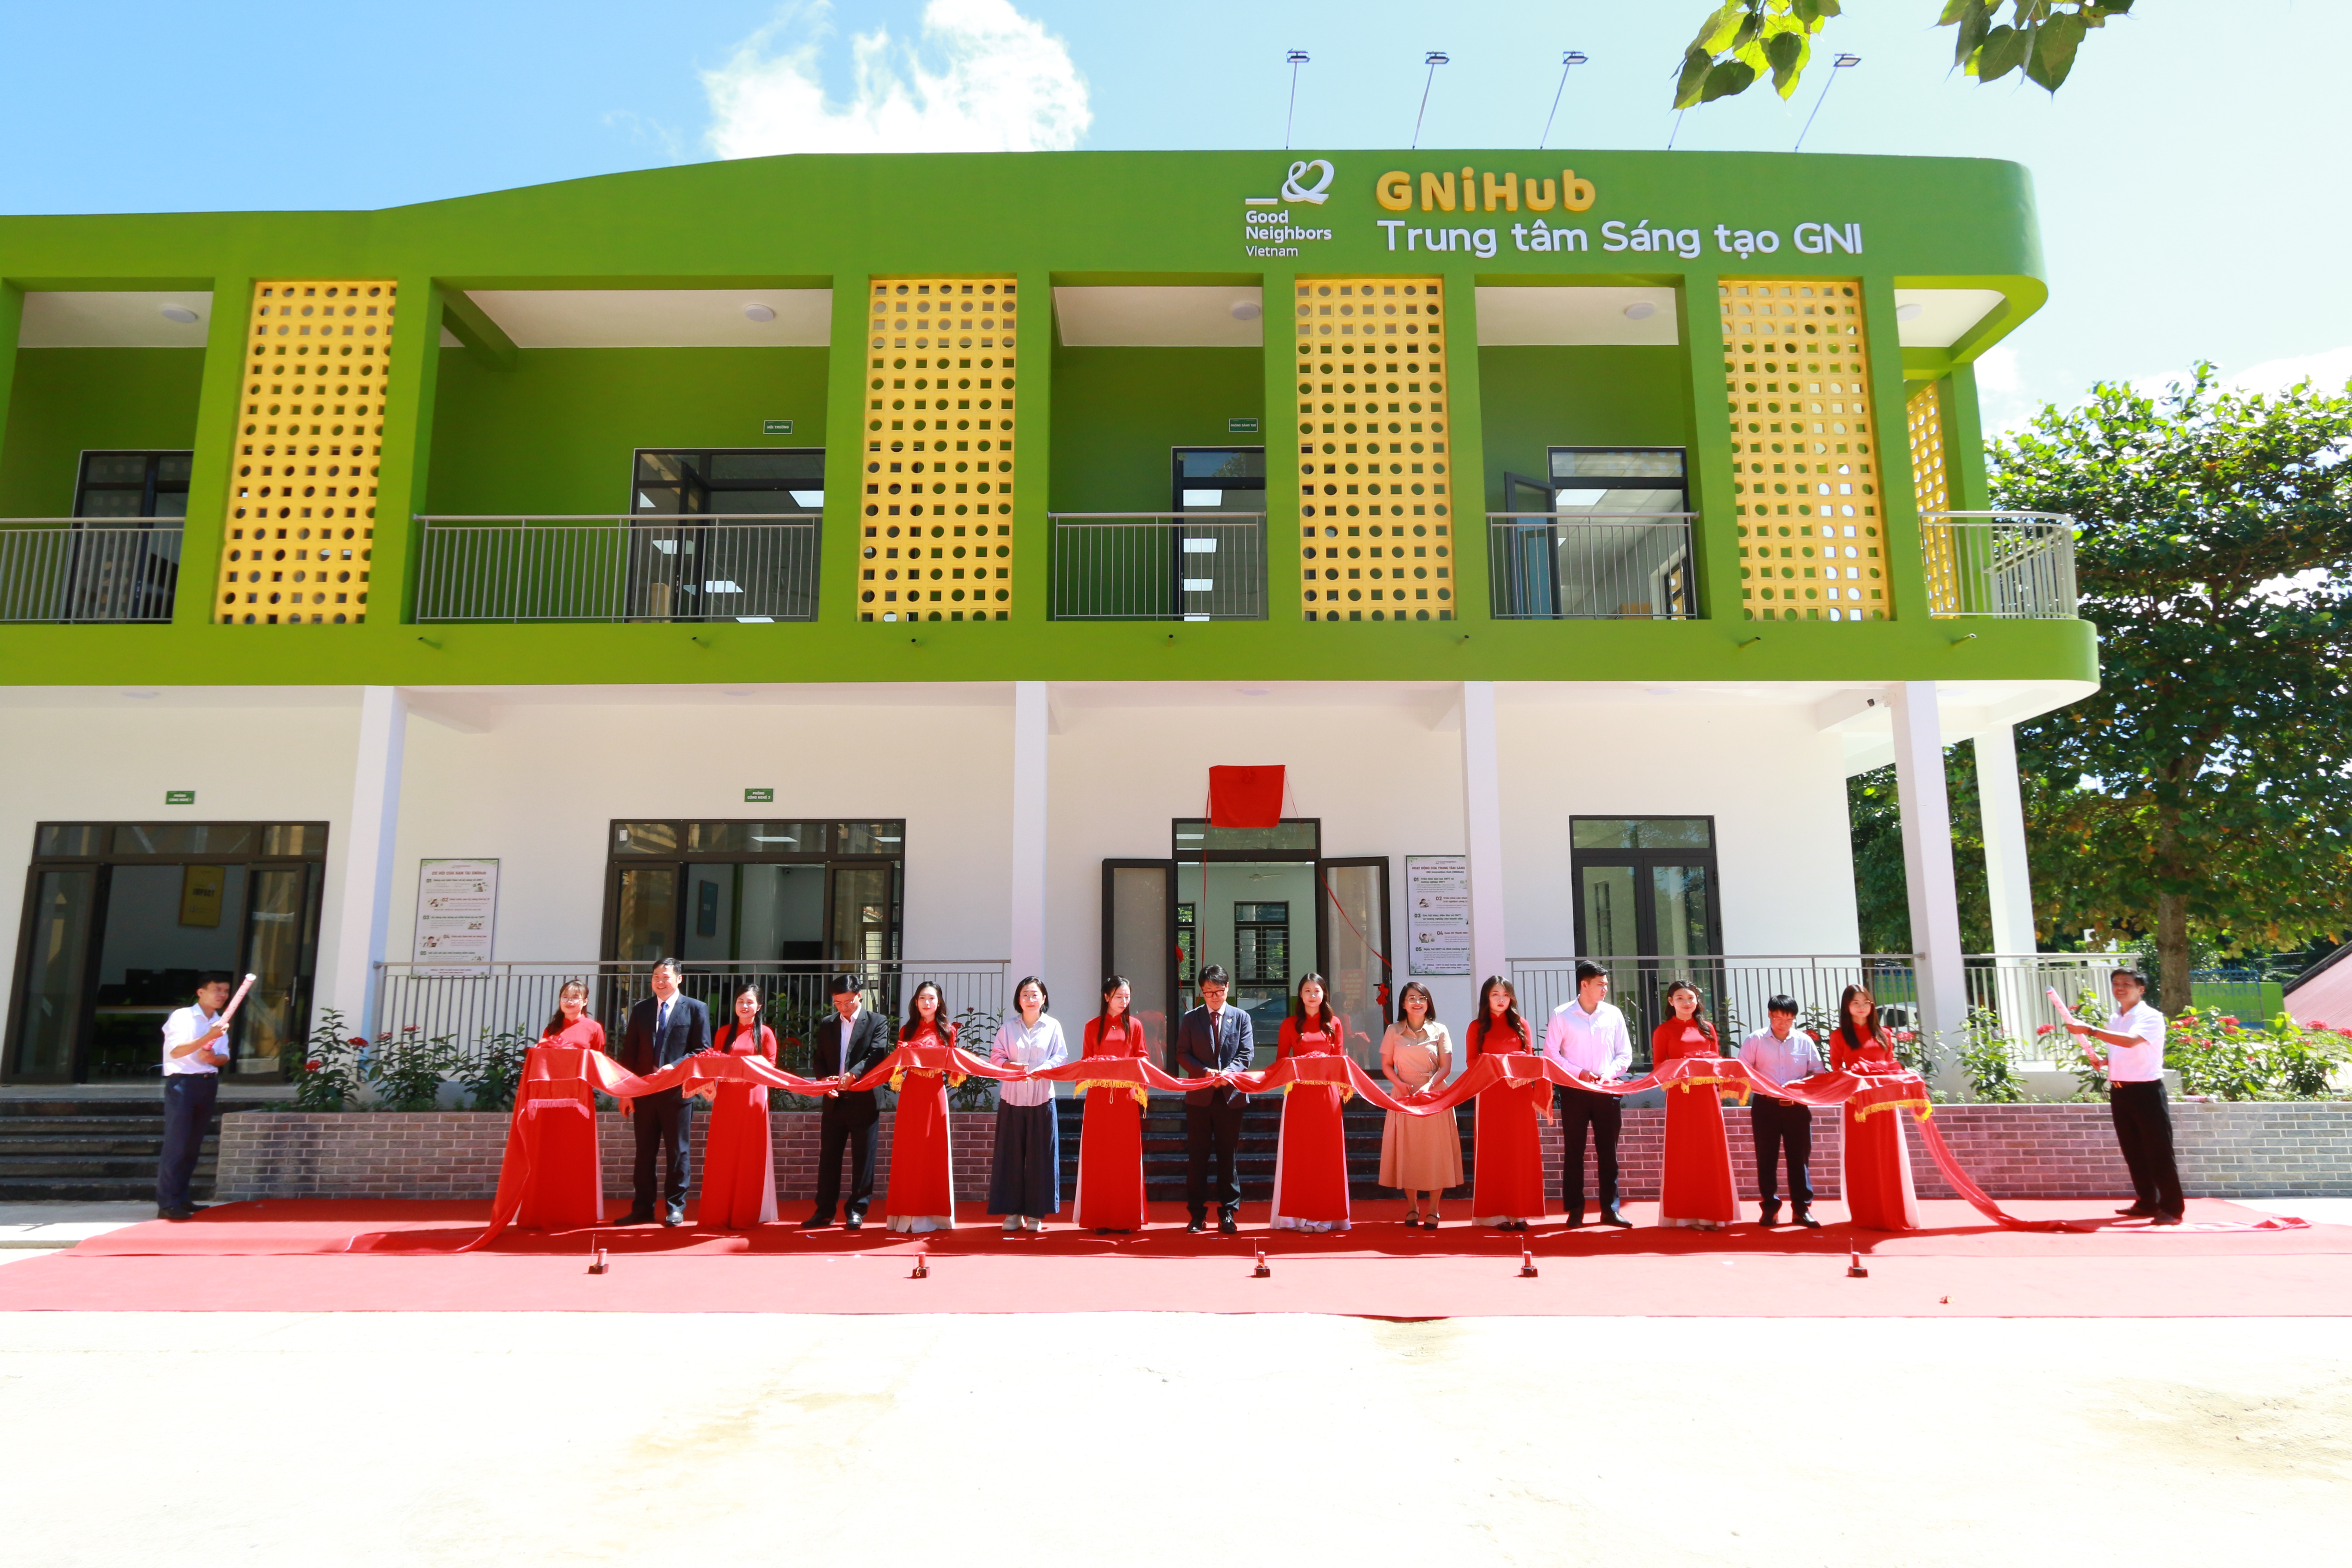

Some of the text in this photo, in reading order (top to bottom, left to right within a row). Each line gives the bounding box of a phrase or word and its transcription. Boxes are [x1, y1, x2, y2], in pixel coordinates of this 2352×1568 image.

[1377, 166, 1596, 211] GNiHub
[1246, 210, 1288, 224] Good
[1246, 226, 1332, 244] Neighbors
[1377, 219, 1863, 259] Trung tâm Sáng tạo GNI
[1246, 245, 1298, 257] Vietnam
